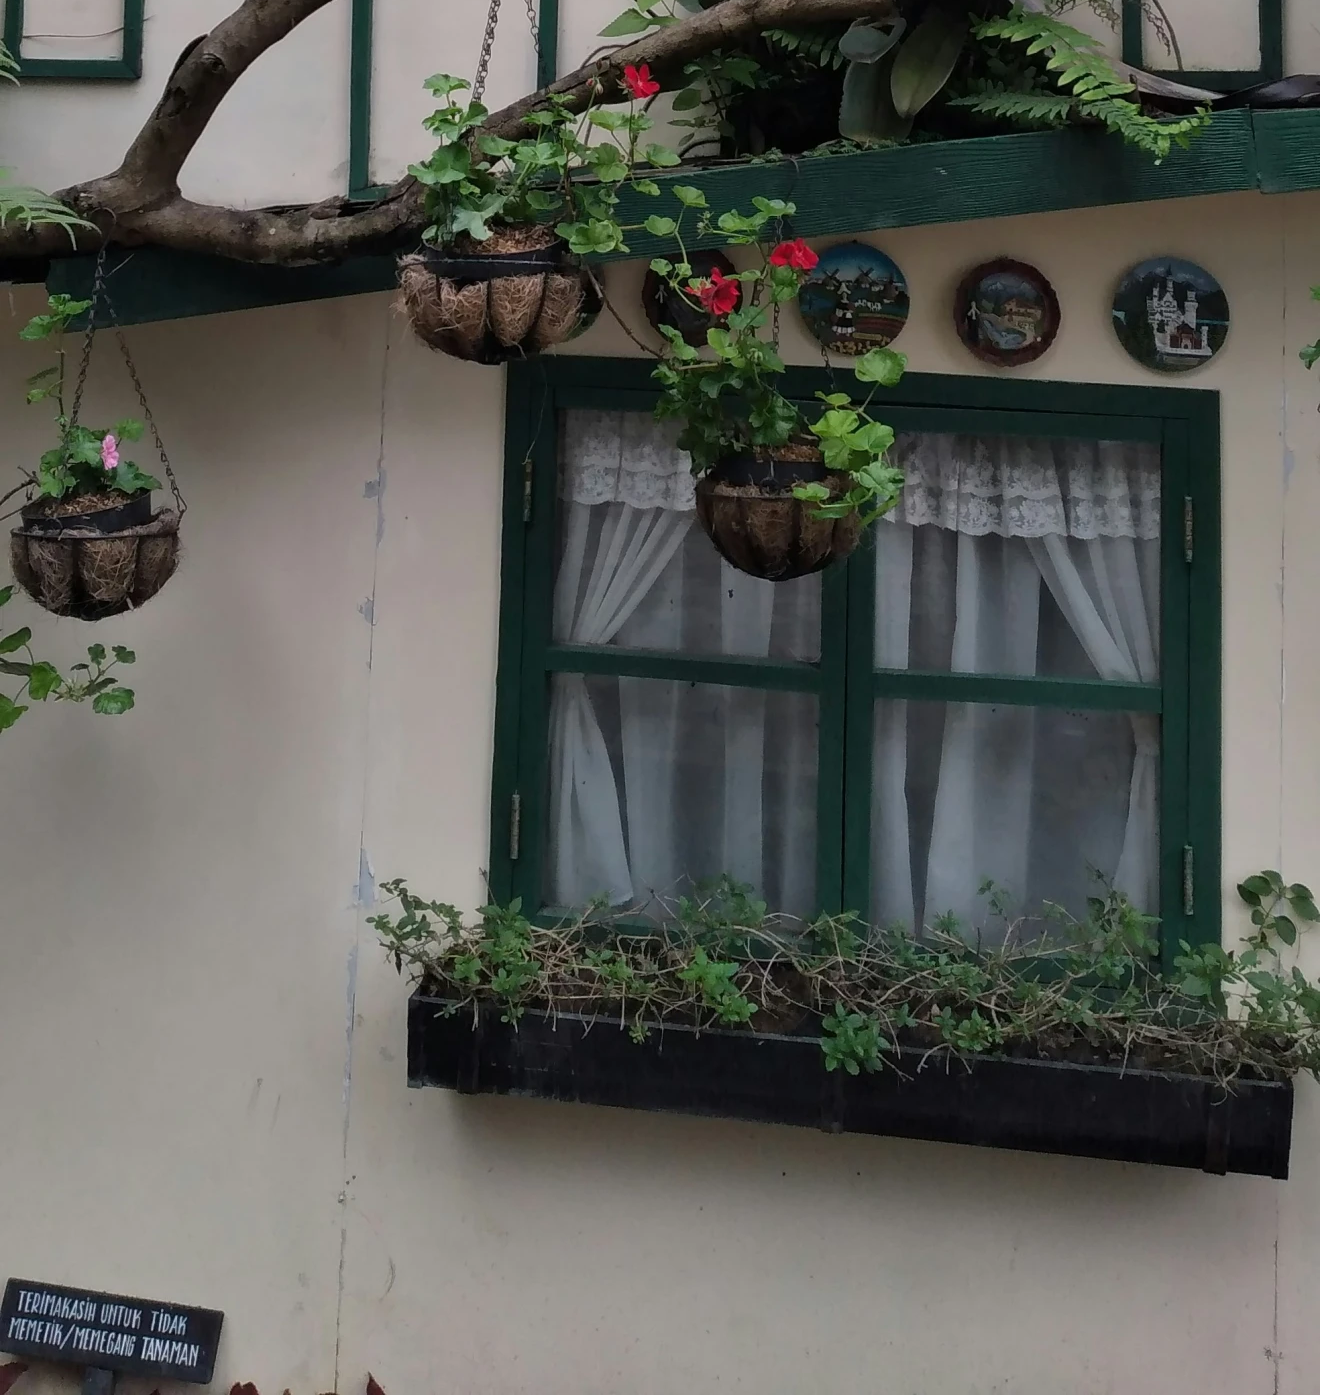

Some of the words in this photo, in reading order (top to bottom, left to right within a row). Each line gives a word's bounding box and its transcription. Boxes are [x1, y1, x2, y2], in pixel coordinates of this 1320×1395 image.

[18, 1290, 96, 1322] TERIMAKASIH
[101, 1304, 142, 1329] UNTUK
[150, 1309, 187, 1335] TIDAK
[141, 1336, 199, 1367] TANAMAN
